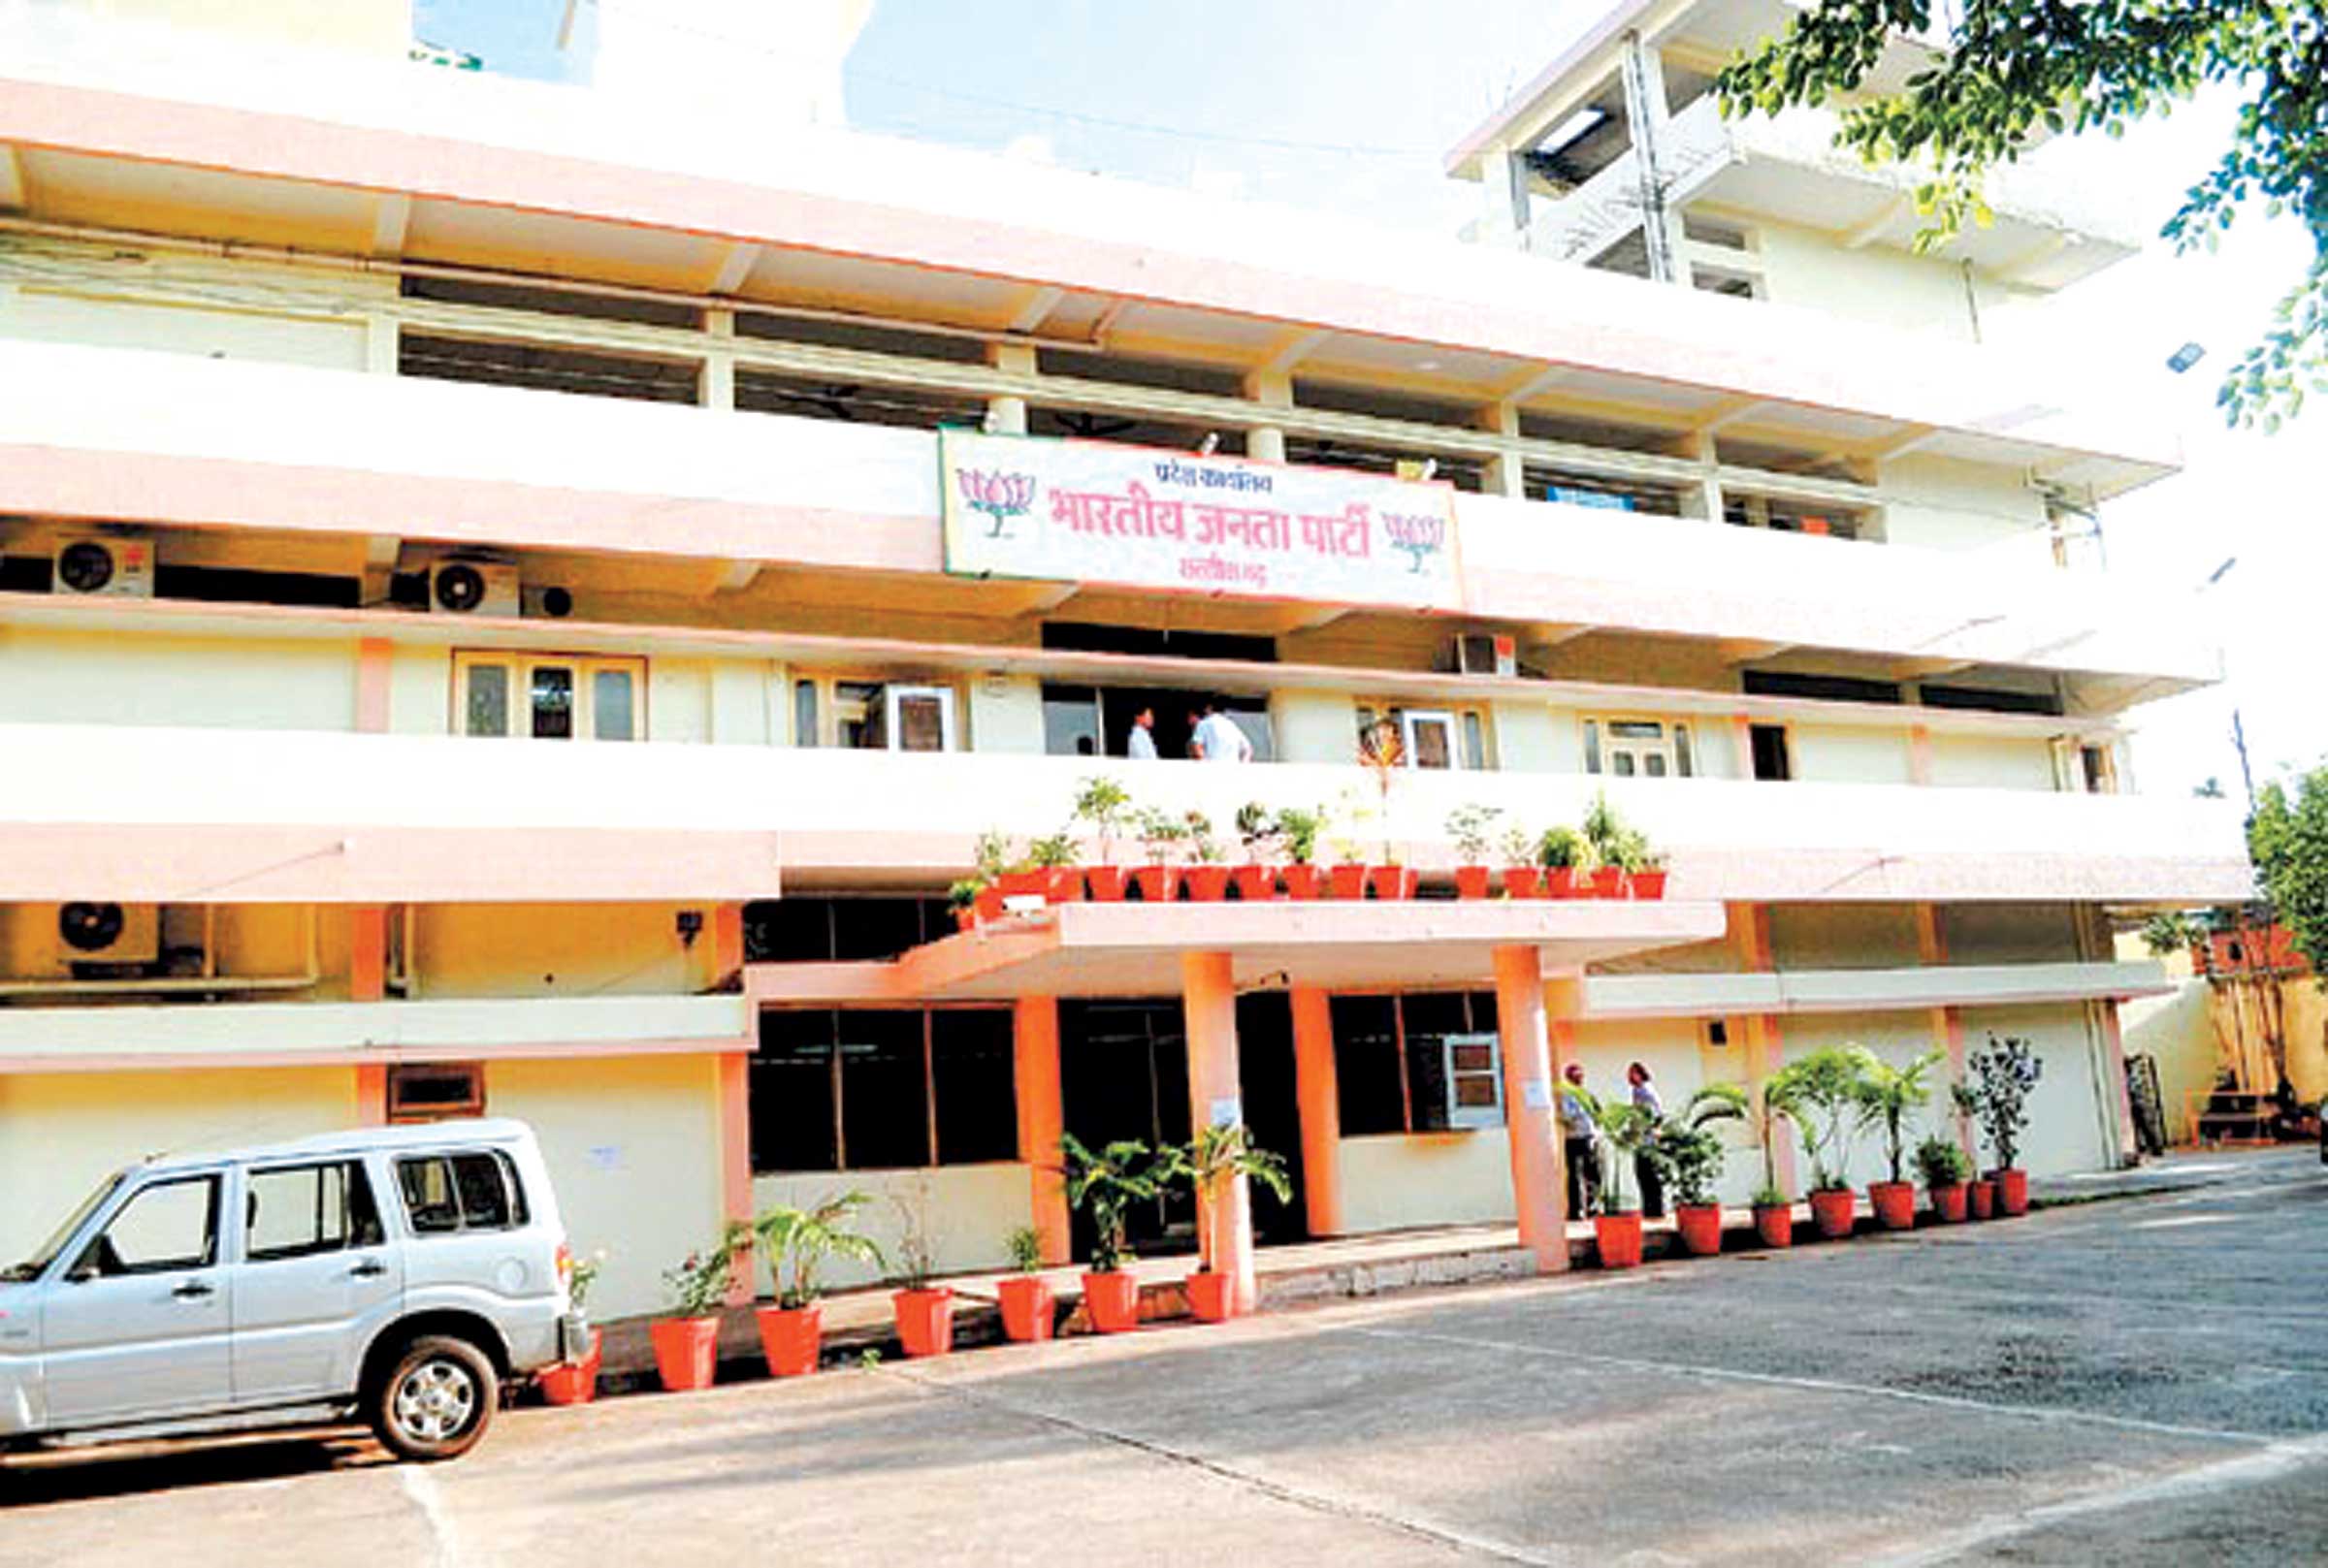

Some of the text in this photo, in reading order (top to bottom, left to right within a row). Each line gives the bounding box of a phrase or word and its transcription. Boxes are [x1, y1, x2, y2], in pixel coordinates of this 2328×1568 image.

[1049, 481, 1370, 558] भारतीय जनता पार्टी
